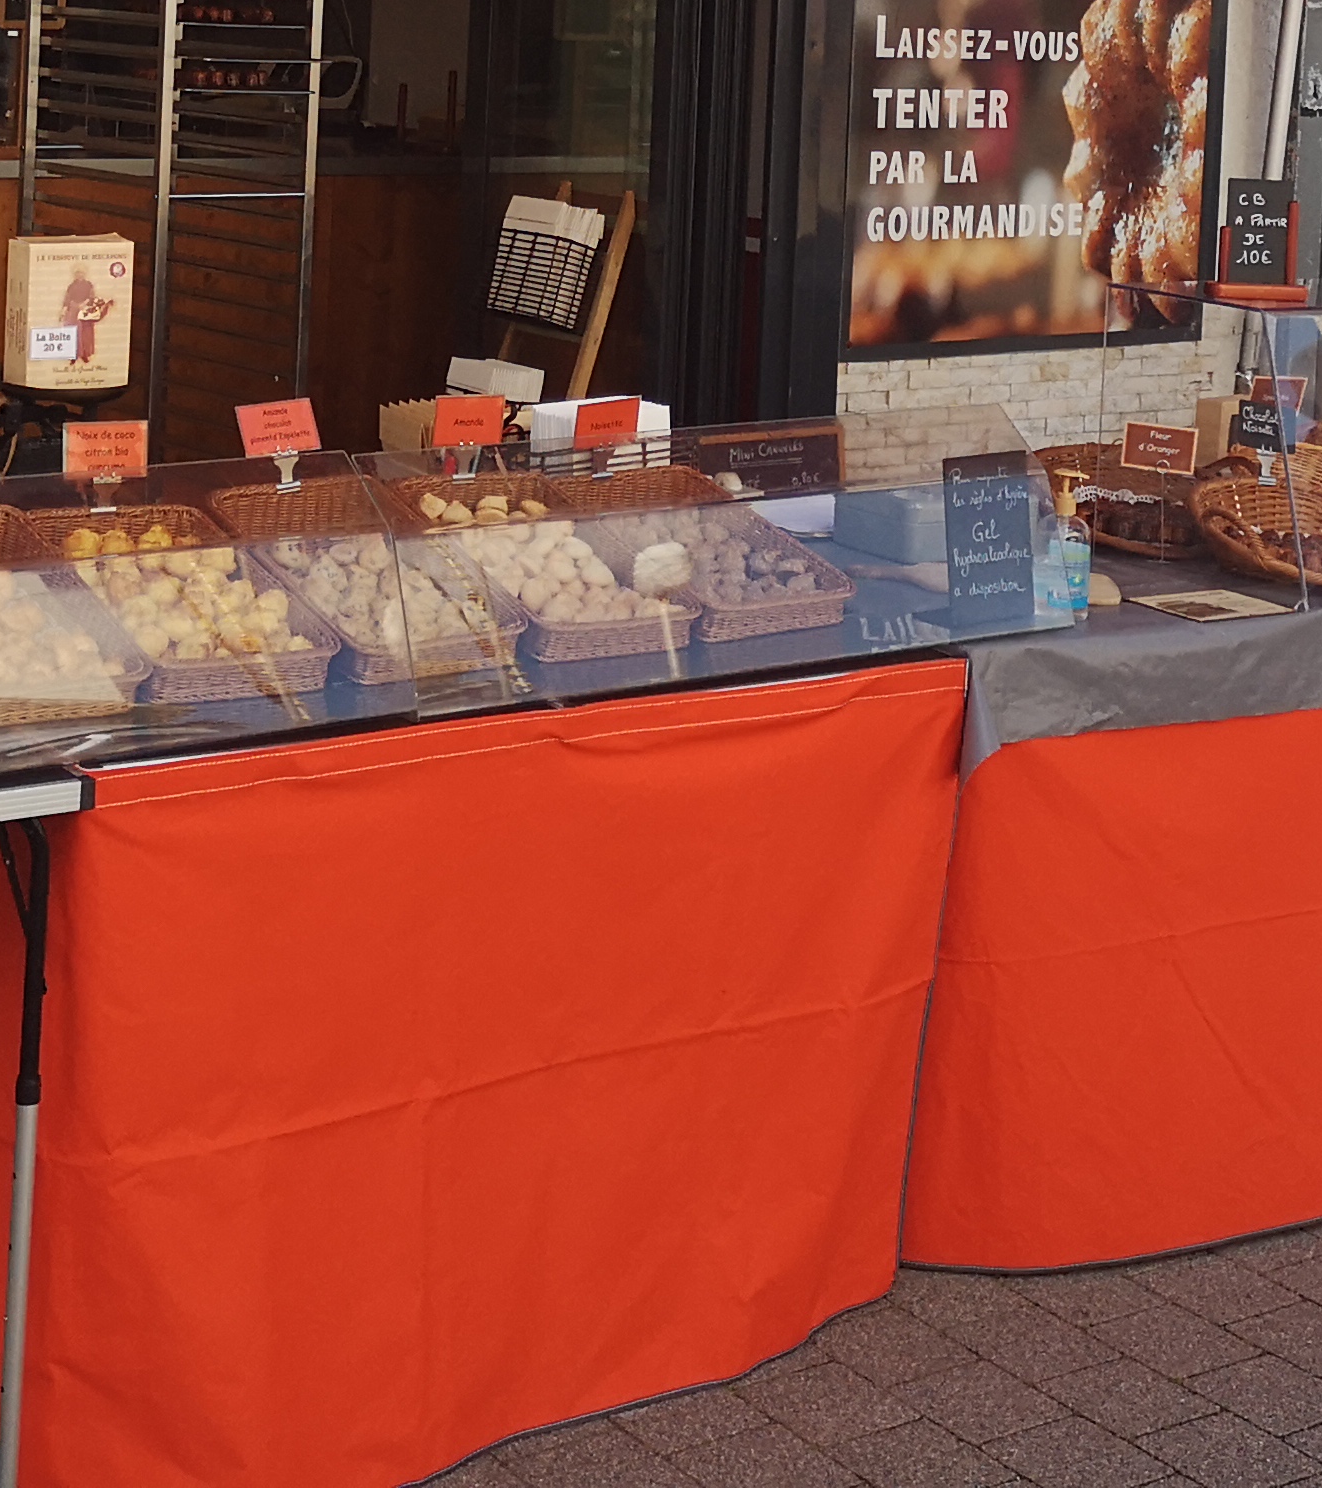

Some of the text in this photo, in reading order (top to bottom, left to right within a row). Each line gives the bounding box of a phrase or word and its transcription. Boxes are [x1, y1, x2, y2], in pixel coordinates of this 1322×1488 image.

[876, 15, 1079, 61] LAISSEZ-VOUS
[873, 89, 1008, 129] TENTER
[869, 150, 978, 184] PAR LA
[867, 203, 1084, 242] GOURMANDISE
[1243, 233, 1265, 246] DE
[1236, 250, 1273, 265] 10€
[36, 333, 46, 341] La
[43, 343, 54, 352] 20
[454, 417, 484, 427] Amande
[590, 419, 623, 431] Noisette
[76, 430, 136, 441] Noix de coco
[972, 518, 1000, 542] Gel
[969, 578, 1026, 599] disposition
